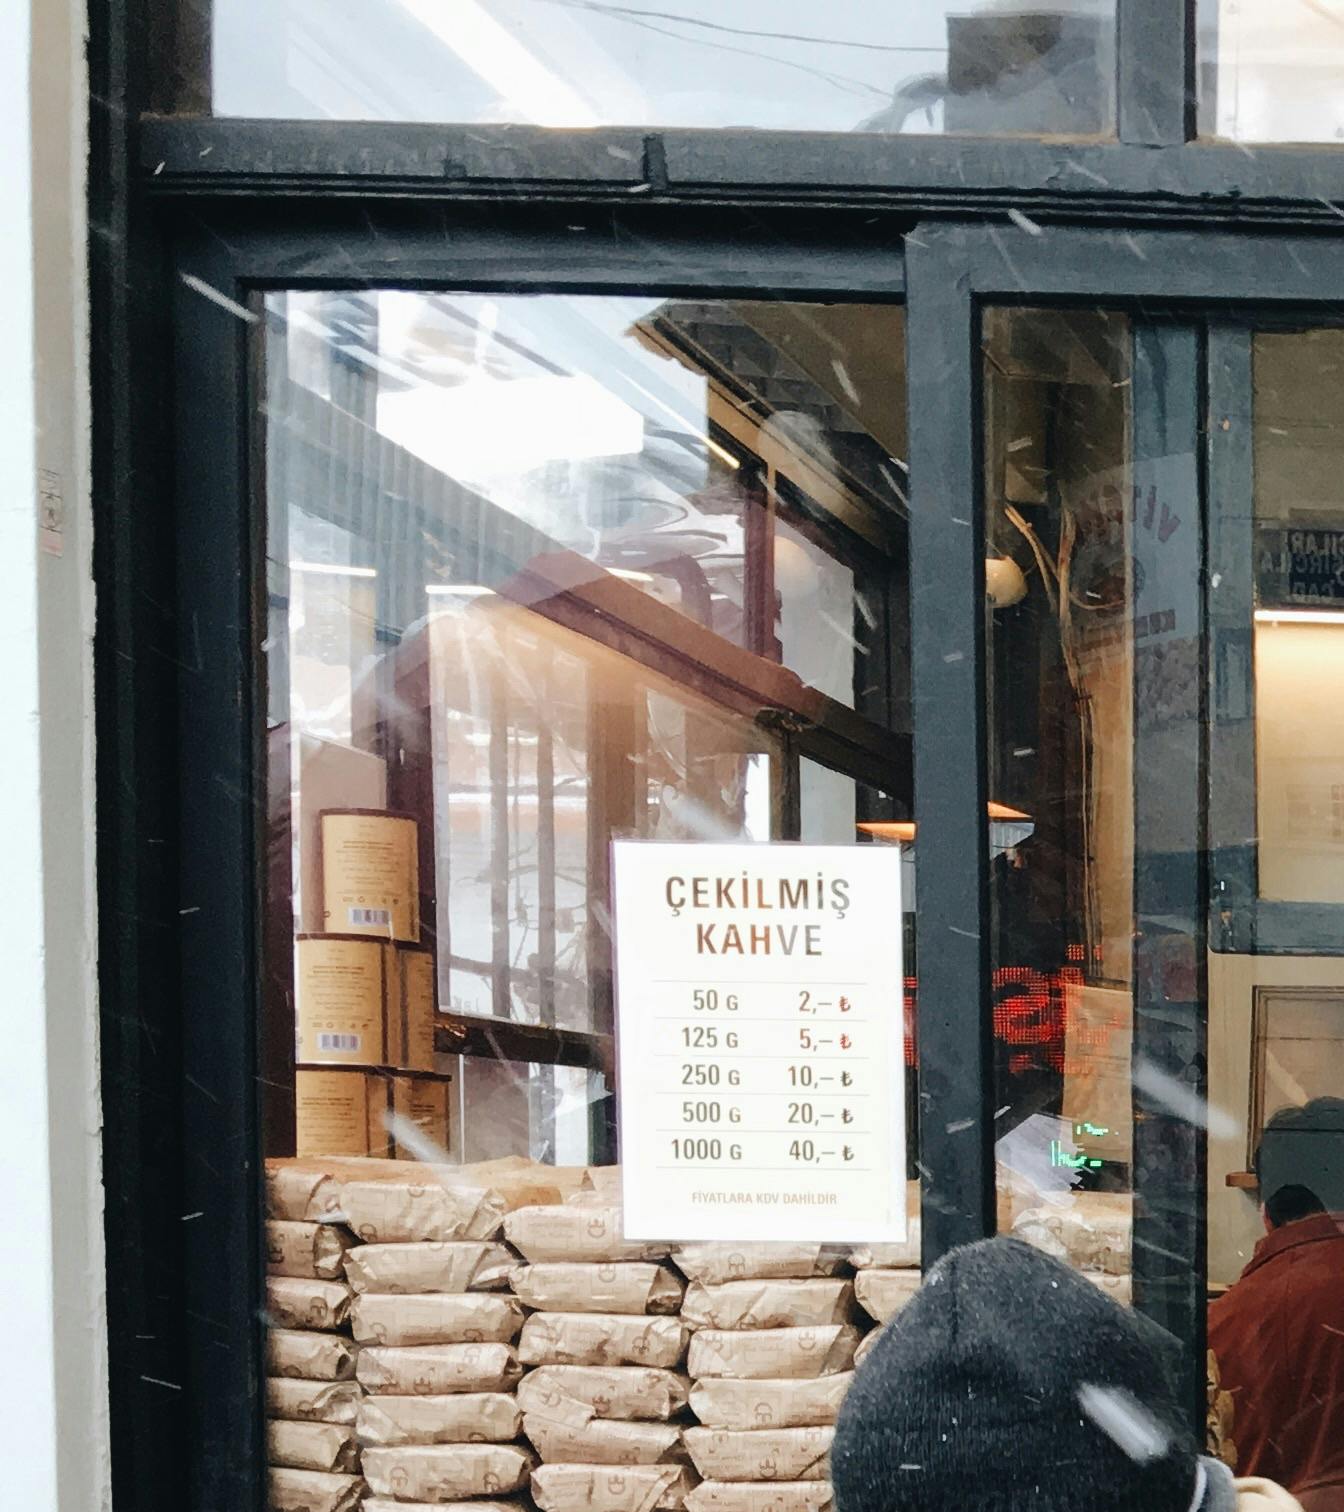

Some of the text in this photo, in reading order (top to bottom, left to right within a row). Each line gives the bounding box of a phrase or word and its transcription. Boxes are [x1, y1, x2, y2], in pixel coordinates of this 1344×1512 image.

[665, 871, 851, 920] ÇEKİLMİŞ
[696, 923, 823, 956] KAHVE
[693, 989, 719, 1011] 50
[726, 995, 739, 1011] G
[682, 1026, 718, 1048] 125
[726, 1032, 738, 1048] G
[682, 1064, 720, 1086] 250
[728, 1069, 741, 1086] G
[682, 1101, 722, 1123] 500
[729, 1107, 742, 1123] G
[671, 1138, 722, 1161] 1000
[729, 1144, 743, 1161] G
[756, 1193, 779, 1205] KDV
